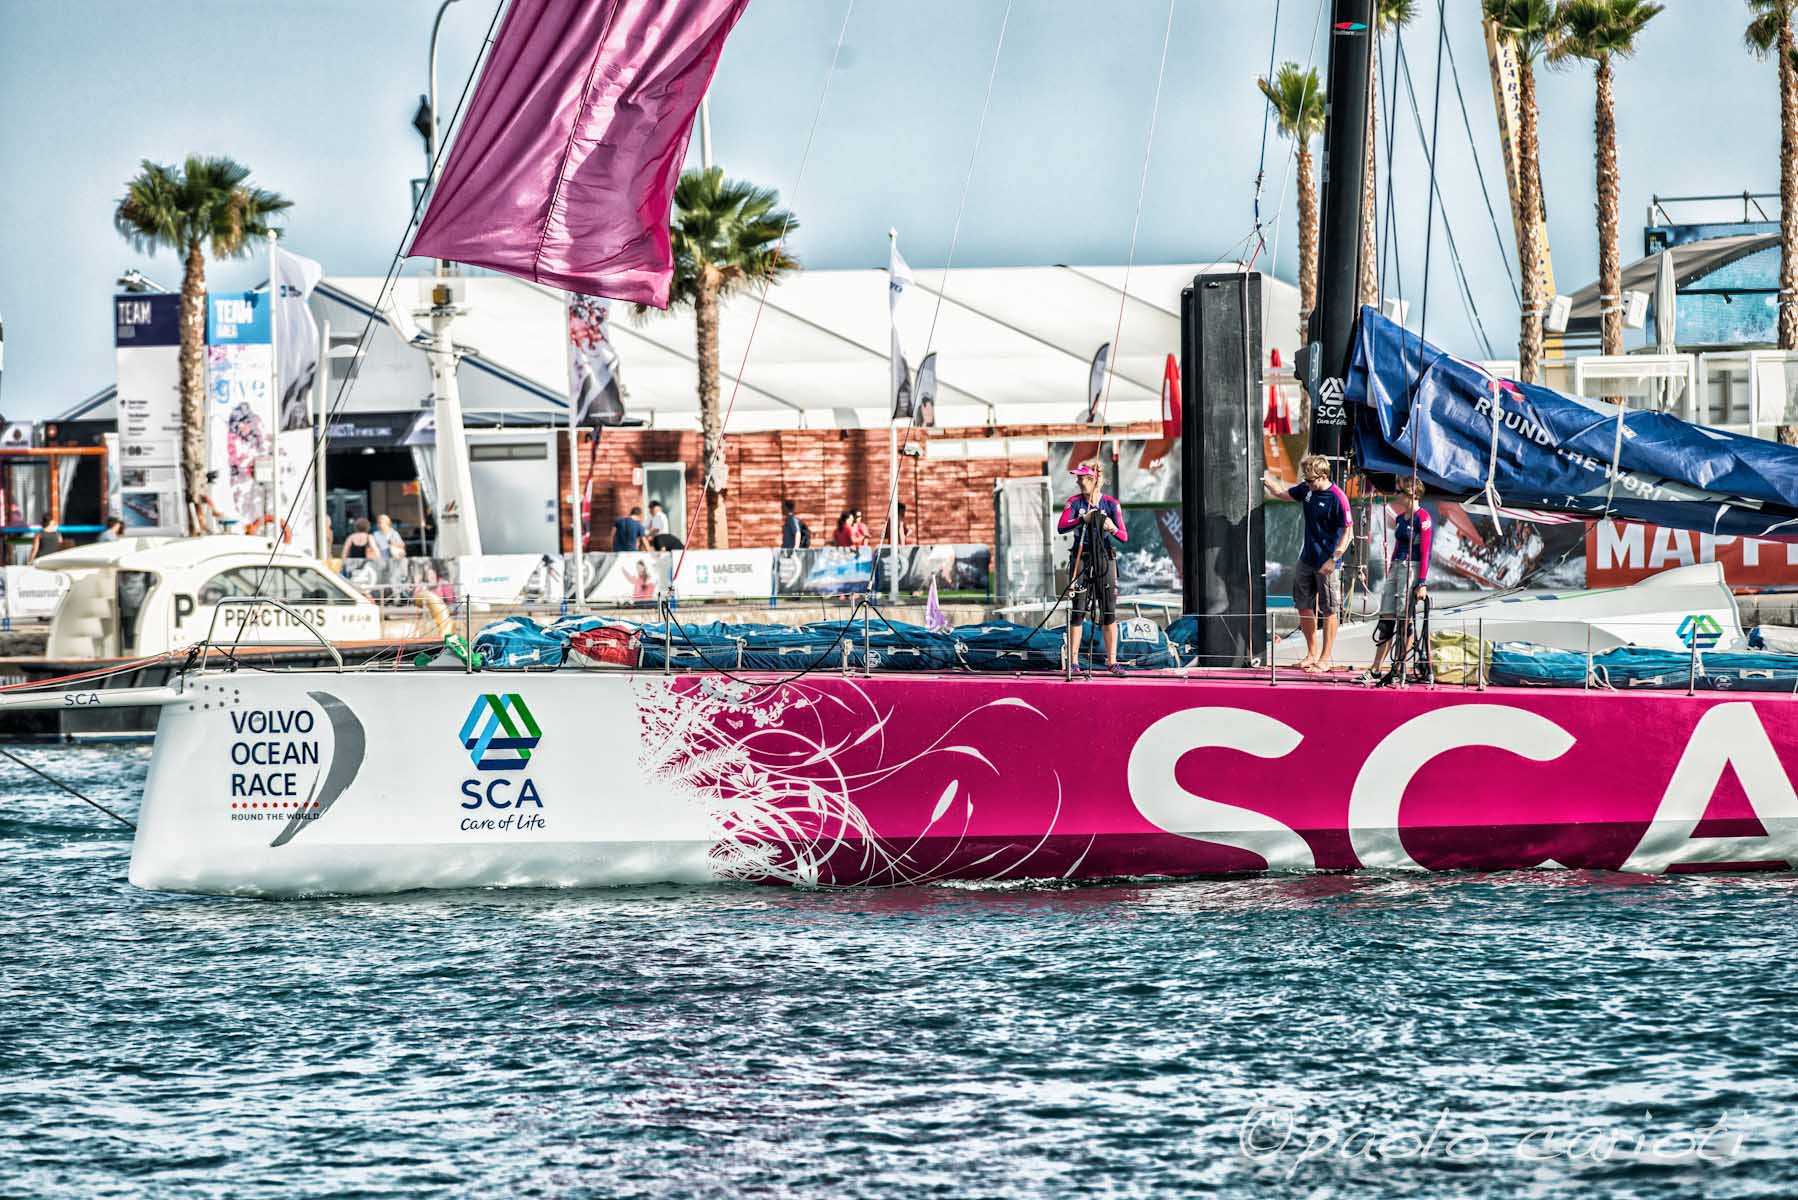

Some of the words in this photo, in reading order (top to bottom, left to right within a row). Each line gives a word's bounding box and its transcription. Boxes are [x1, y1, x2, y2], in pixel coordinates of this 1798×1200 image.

[117, 301, 151, 324] TEAM
[214, 300, 253, 324] TEAM
[1317, 405, 1347, 418] SCA
[174, 594, 194, 628] P
[1134, 623, 1151, 633] A3
[64, 693, 101, 706] SCA
[230, 710, 314, 734] VOLVO
[231, 741, 318, 765] OCEAN
[232, 773, 296, 796] RACE
[461, 778, 544, 809] SCA
[1127, 703, 1798, 871] SCA
[231, 813, 263, 821] ROUND
[266, 813, 284, 821] THE
[287, 812, 319, 821] WORLD
[460, 818, 496, 831] Care
[498, 814, 514, 832] of
